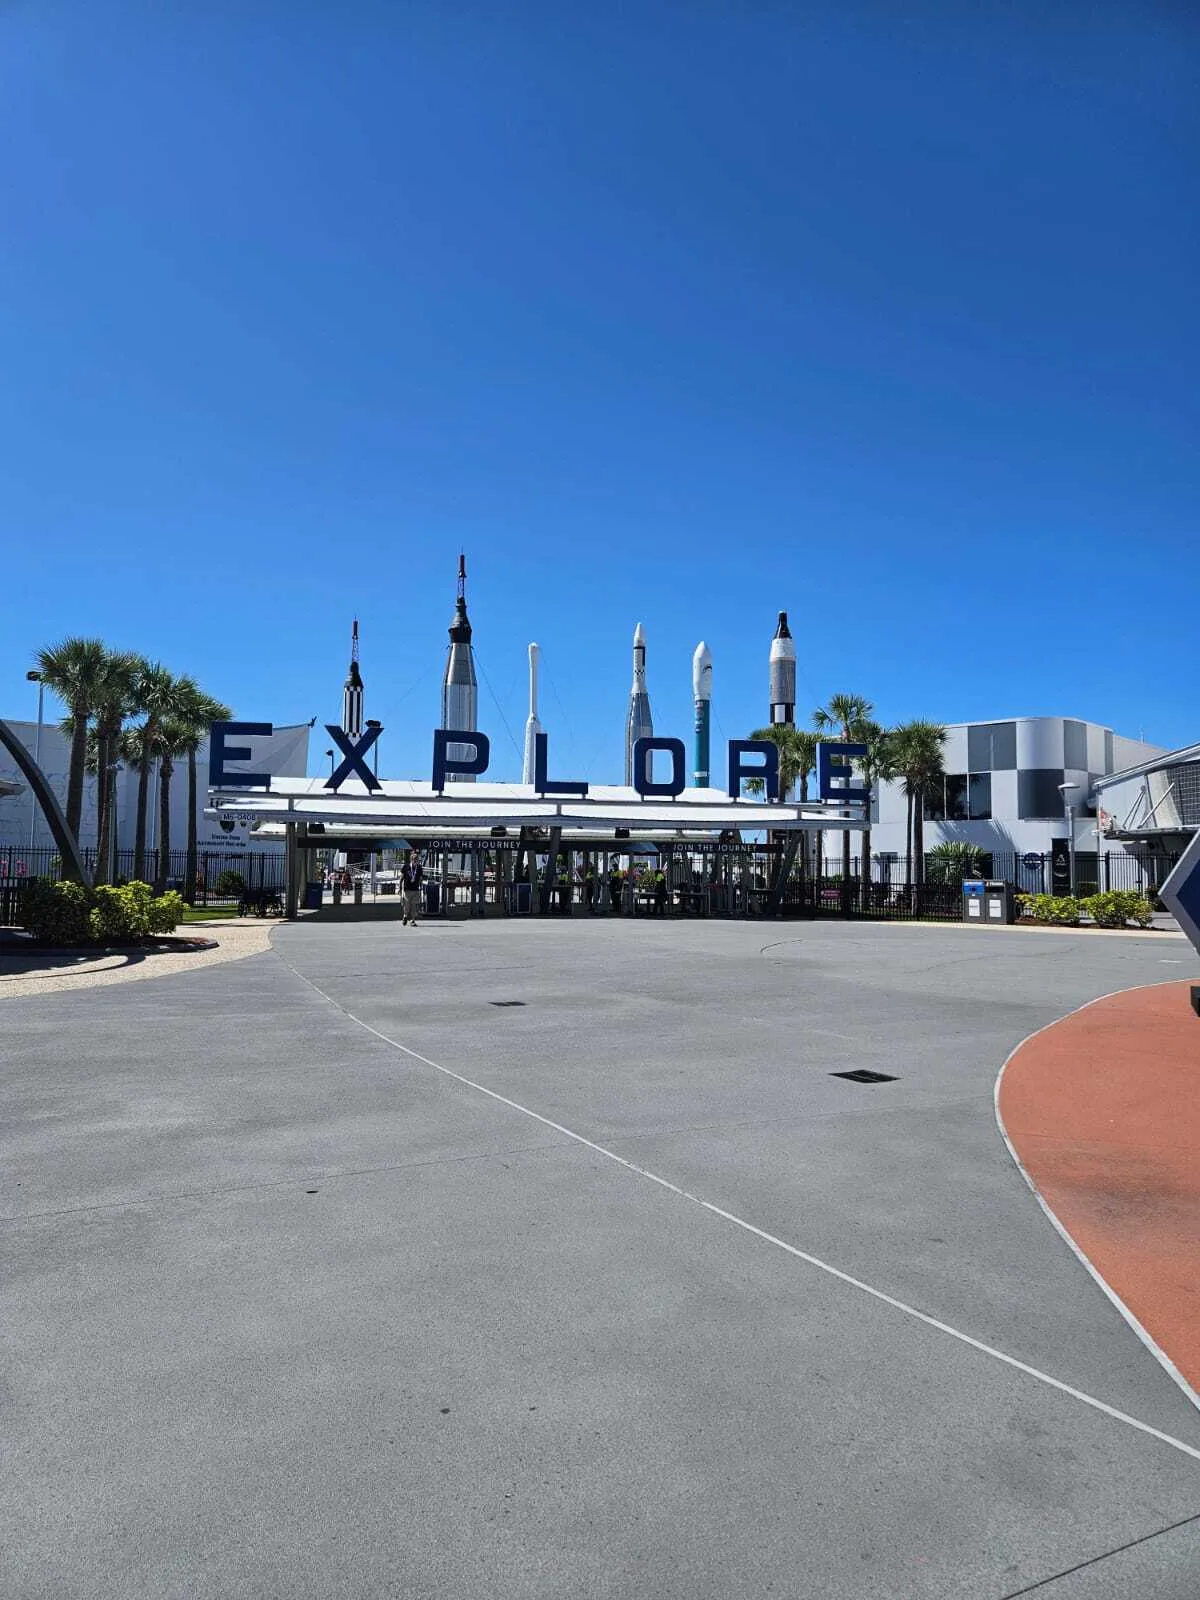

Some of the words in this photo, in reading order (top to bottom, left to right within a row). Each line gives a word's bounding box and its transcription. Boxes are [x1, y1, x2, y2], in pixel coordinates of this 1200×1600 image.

[208, 721, 869, 800] EXPLORE
[428, 840, 451, 849] JOIN
[456, 840, 474, 849] THE
[478, 840, 521, 849] JOURNEY
[673, 843, 694, 852] JOIN
[697, 843, 713, 852] THE
[718, 843, 758, 852] JOURNEY
